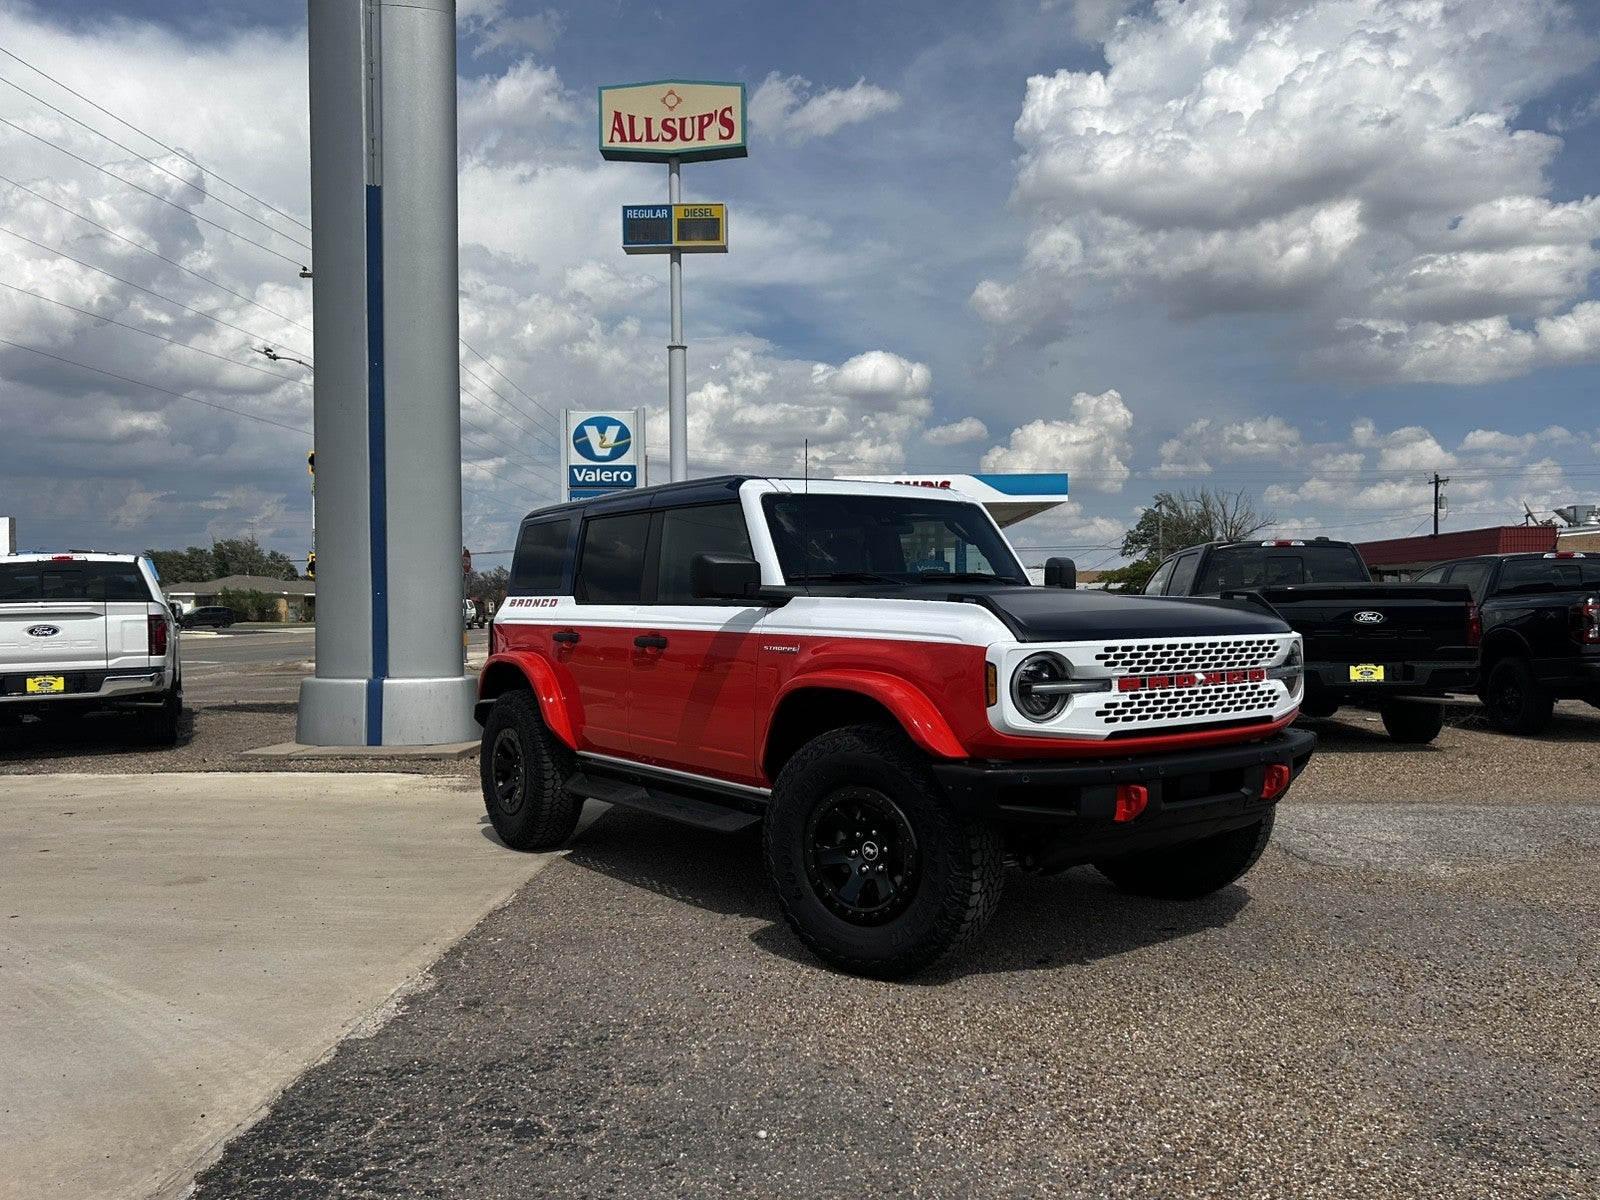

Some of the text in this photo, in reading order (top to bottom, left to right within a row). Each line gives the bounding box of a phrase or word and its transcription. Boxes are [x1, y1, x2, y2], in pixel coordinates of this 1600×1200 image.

[608, 106, 735, 143] ALLSUP'S
[626, 209, 668, 219] REGULAR
[683, 208, 714, 218] DIESEL
[573, 468, 632, 482] Valero
[508, 598, 559, 608] BRONCO
[1358, 612, 1379, 621] Ford
[31, 626, 54, 636] Ford
